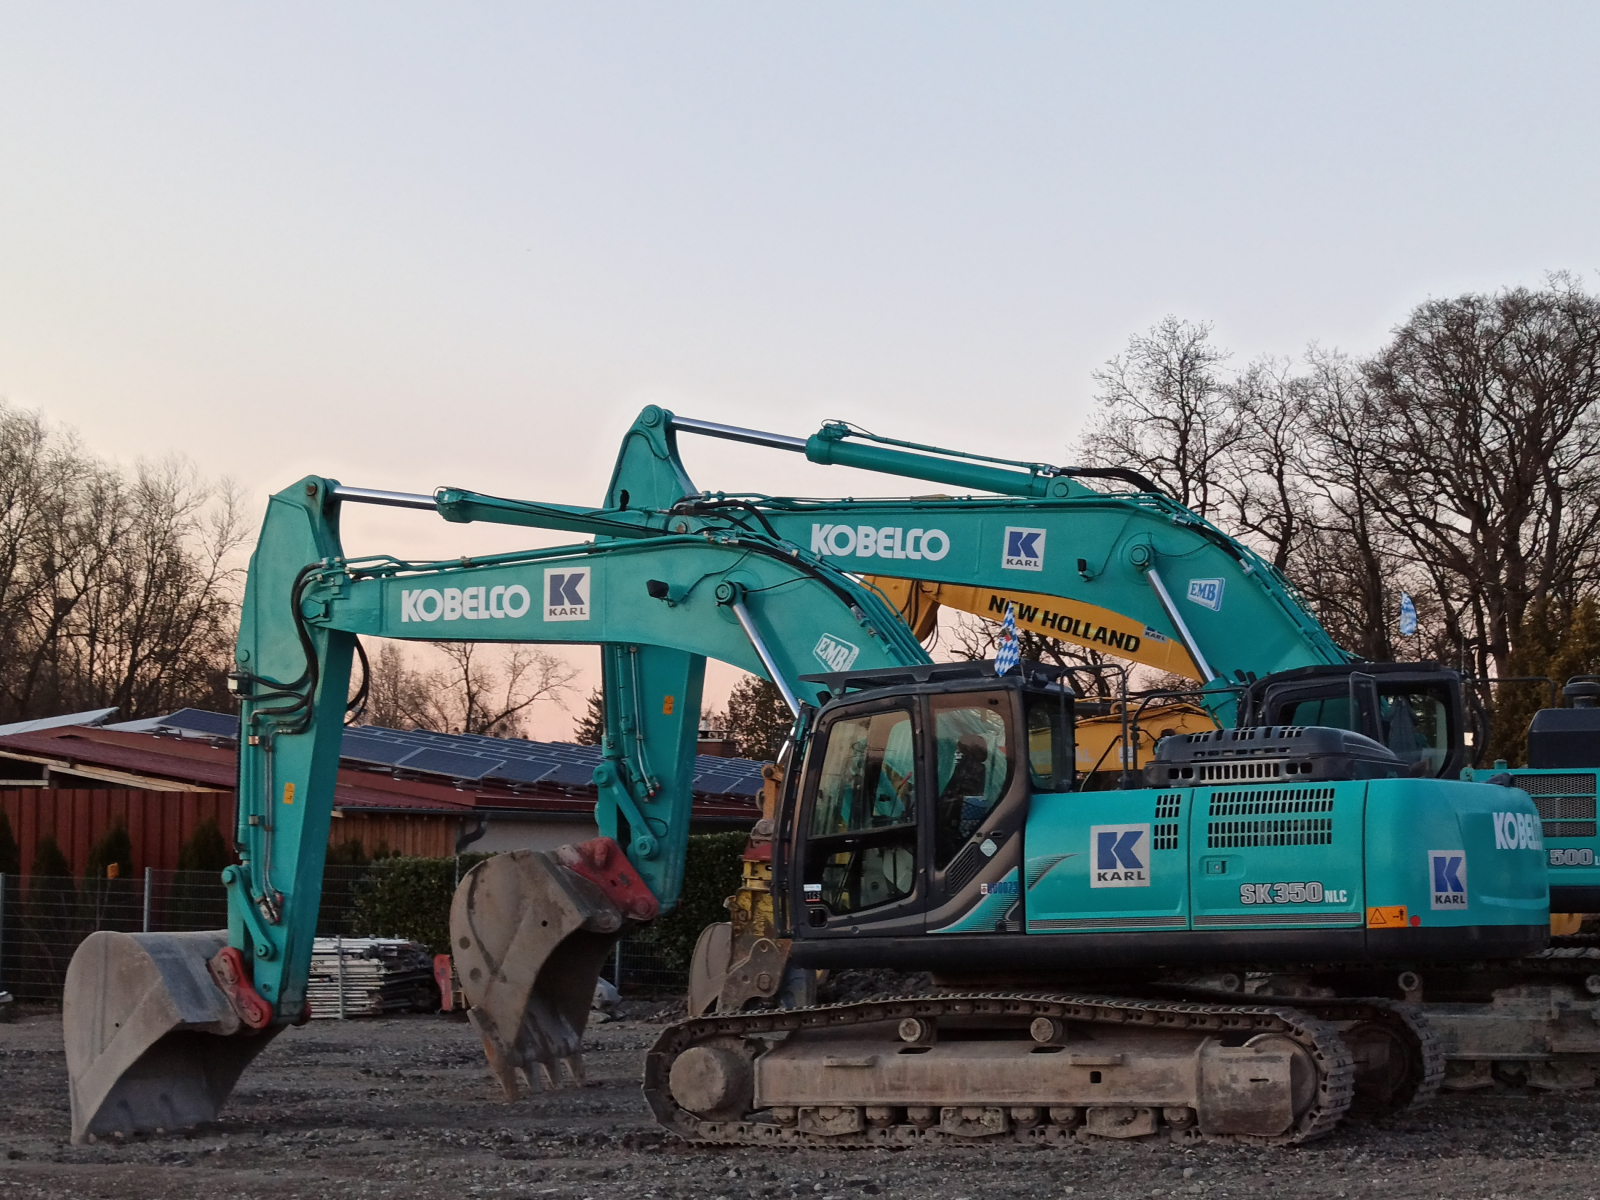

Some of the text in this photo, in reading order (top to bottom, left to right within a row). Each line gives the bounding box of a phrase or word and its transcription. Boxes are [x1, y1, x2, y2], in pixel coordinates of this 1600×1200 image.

[811, 523, 950, 561] KOBELCO
[1006, 558, 1040, 568] KARL
[1190, 583, 1217, 602] EMB
[401, 584, 531, 623] KOBELCO
[549, 607, 587, 616] KARL
[1041, 610, 1141, 653] HOLLAND
[1145, 631, 1166, 642] KARL
[816, 637, 850, 672] EMB
[1097, 871, 1146, 882] KARL
[1240, 881, 1348, 905] SK350 NLC
[1435, 894, 1466, 904] KARL
